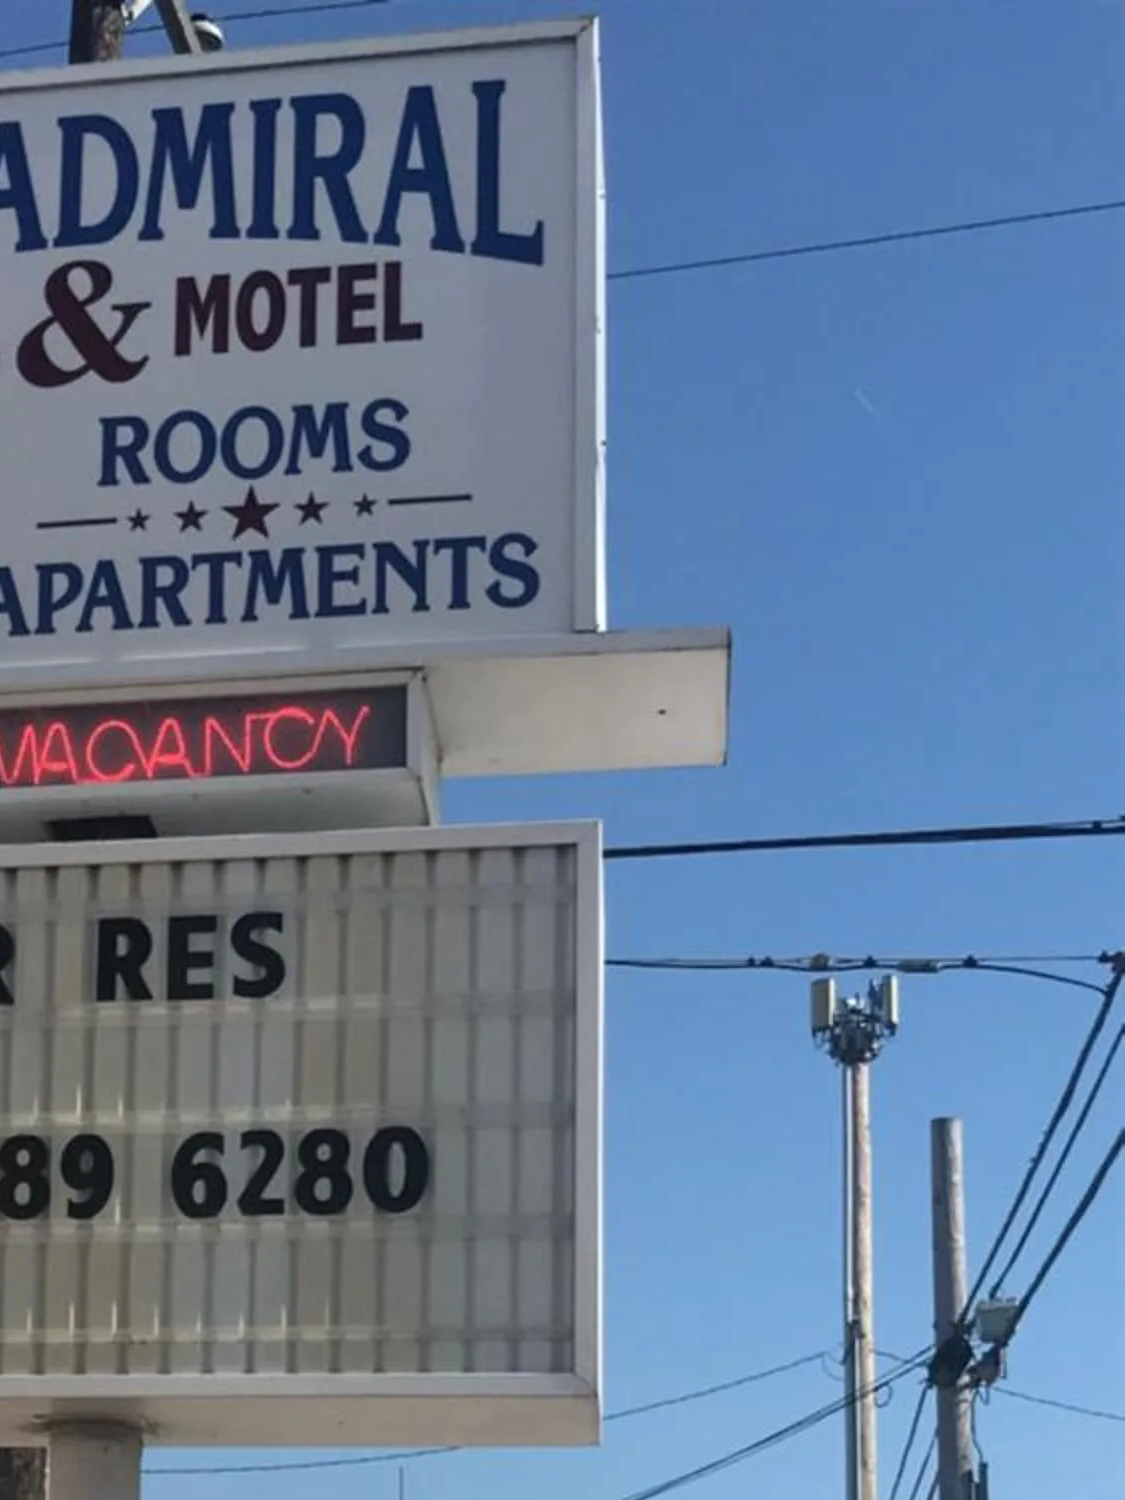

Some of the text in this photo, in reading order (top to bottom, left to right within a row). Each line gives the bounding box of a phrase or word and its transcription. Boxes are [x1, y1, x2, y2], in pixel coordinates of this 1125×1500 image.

[15, 259, 151, 388] &
[173, 261, 423, 357] MOTEL
[98, 398, 411, 488] ROOMS
[96, 911, 288, 1003] RES
[170, 1125, 431, 1219] 6280
